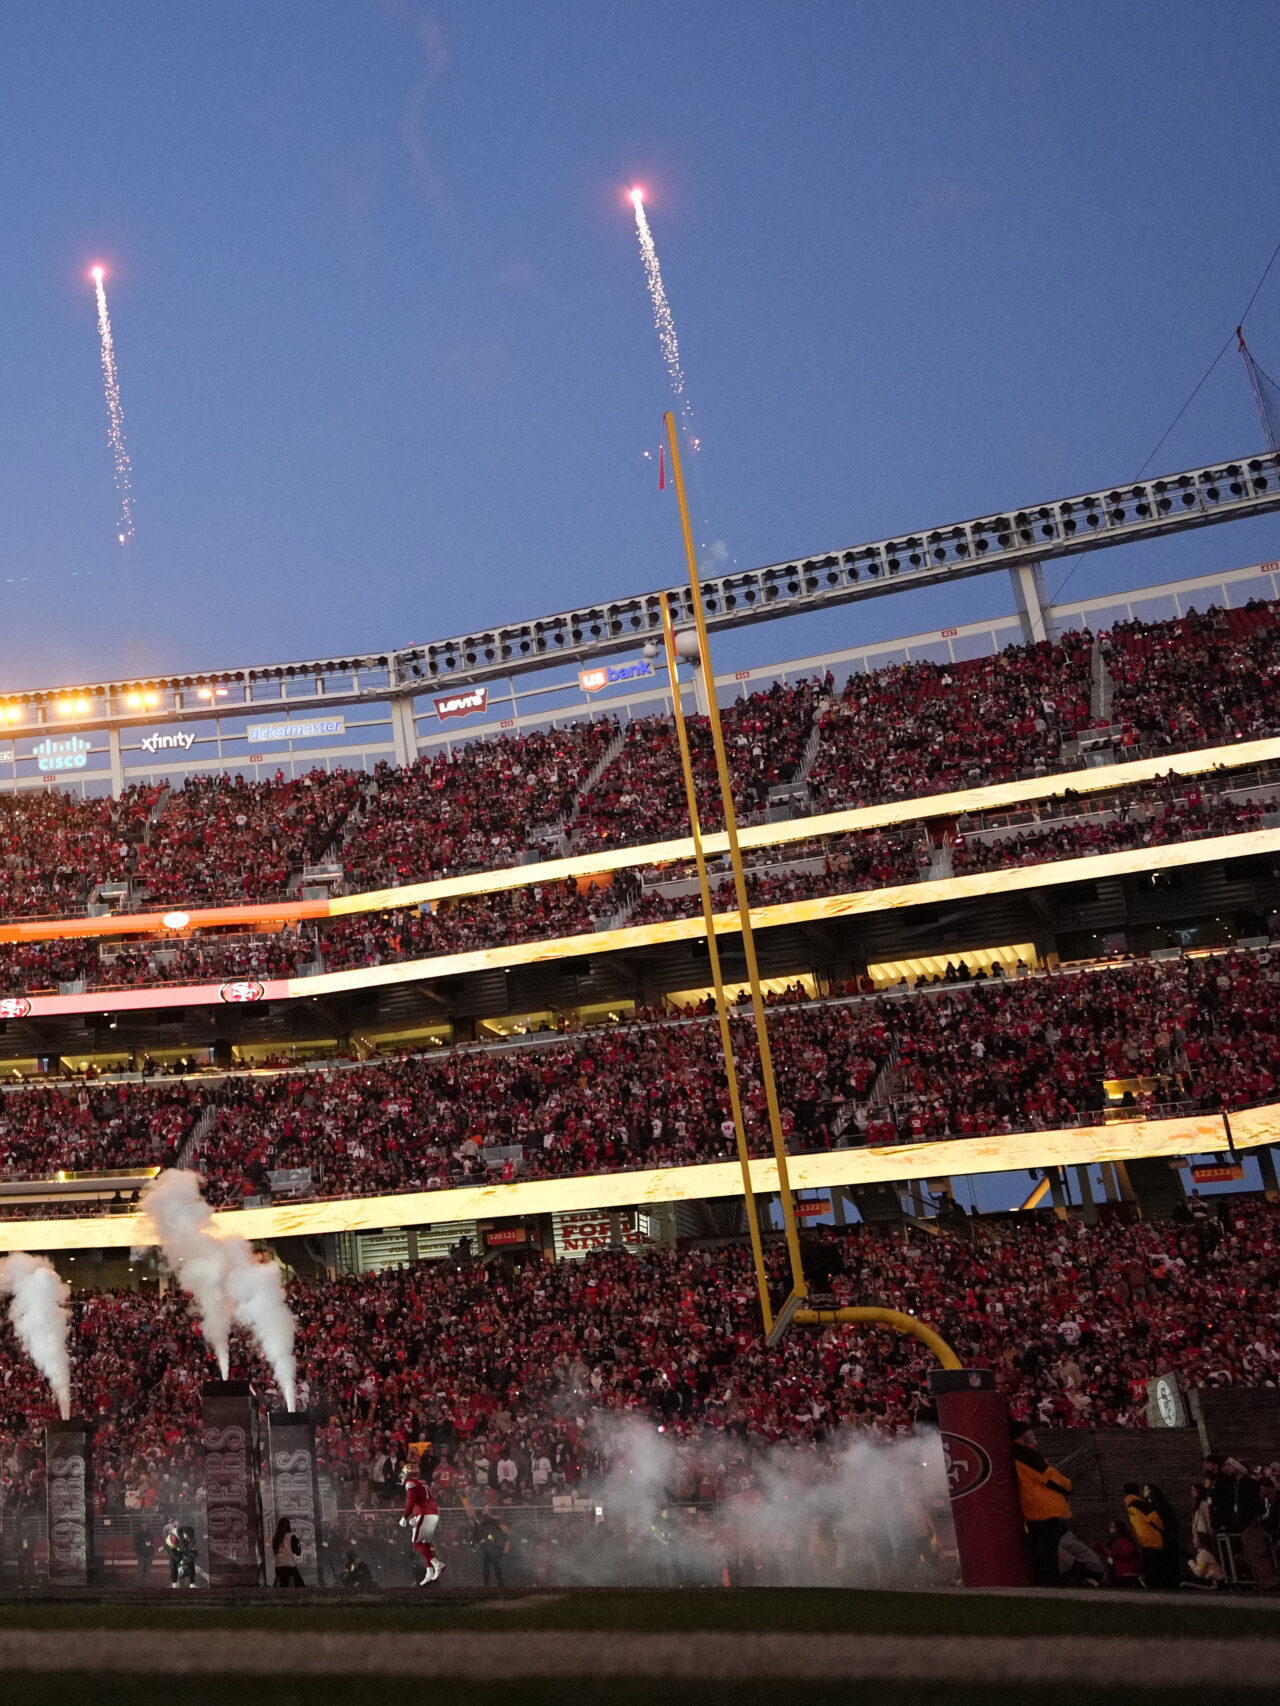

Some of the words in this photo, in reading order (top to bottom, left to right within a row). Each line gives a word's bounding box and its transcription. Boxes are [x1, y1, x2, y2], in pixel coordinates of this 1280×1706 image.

[607, 660, 651, 682] bank
[250, 719, 343, 741] ticketmaster
[141, 731, 196, 754] xfinity
[203, 1425, 248, 1561] 49ERS
[51, 1455, 86, 1567] 49ERS
